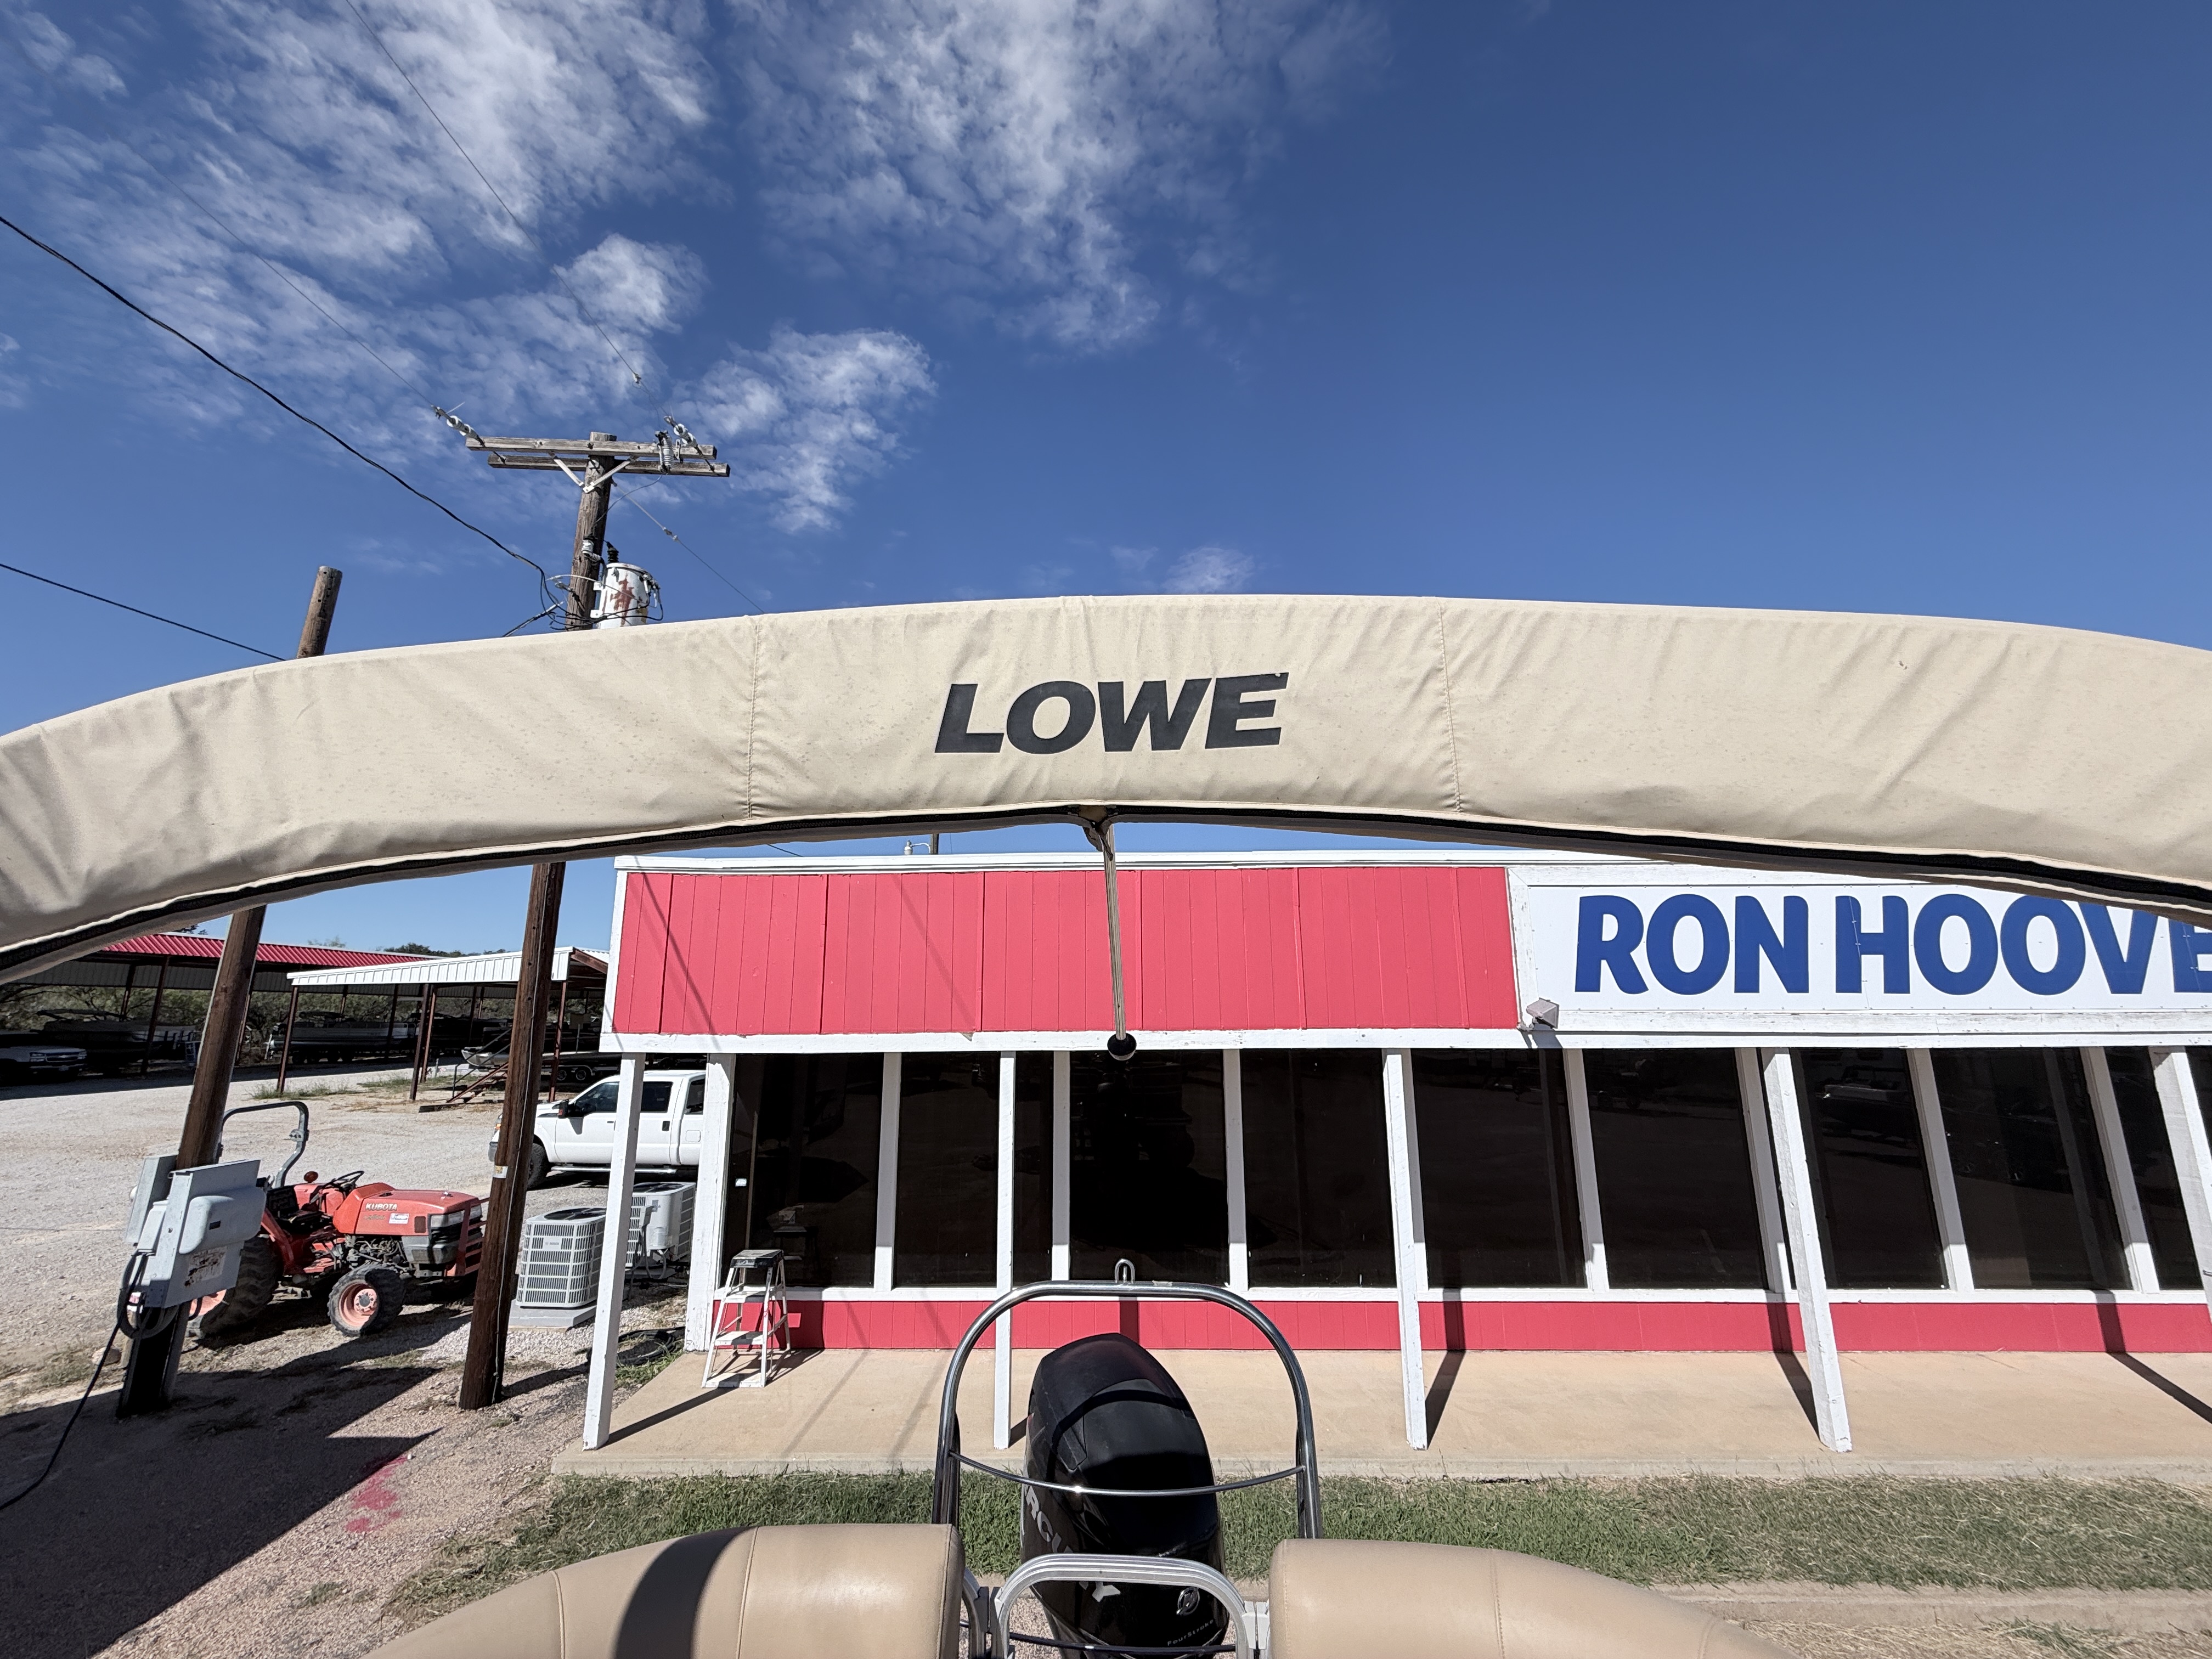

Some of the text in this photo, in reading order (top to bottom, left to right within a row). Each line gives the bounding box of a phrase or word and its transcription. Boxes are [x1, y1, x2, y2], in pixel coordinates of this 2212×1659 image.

[934, 672, 1289, 755] LOWE
[1575, 894, 1809, 994] RON
[365, 1203, 398, 1211] KUBOTA
[1167, 1619, 1214, 1646] FourStroke
